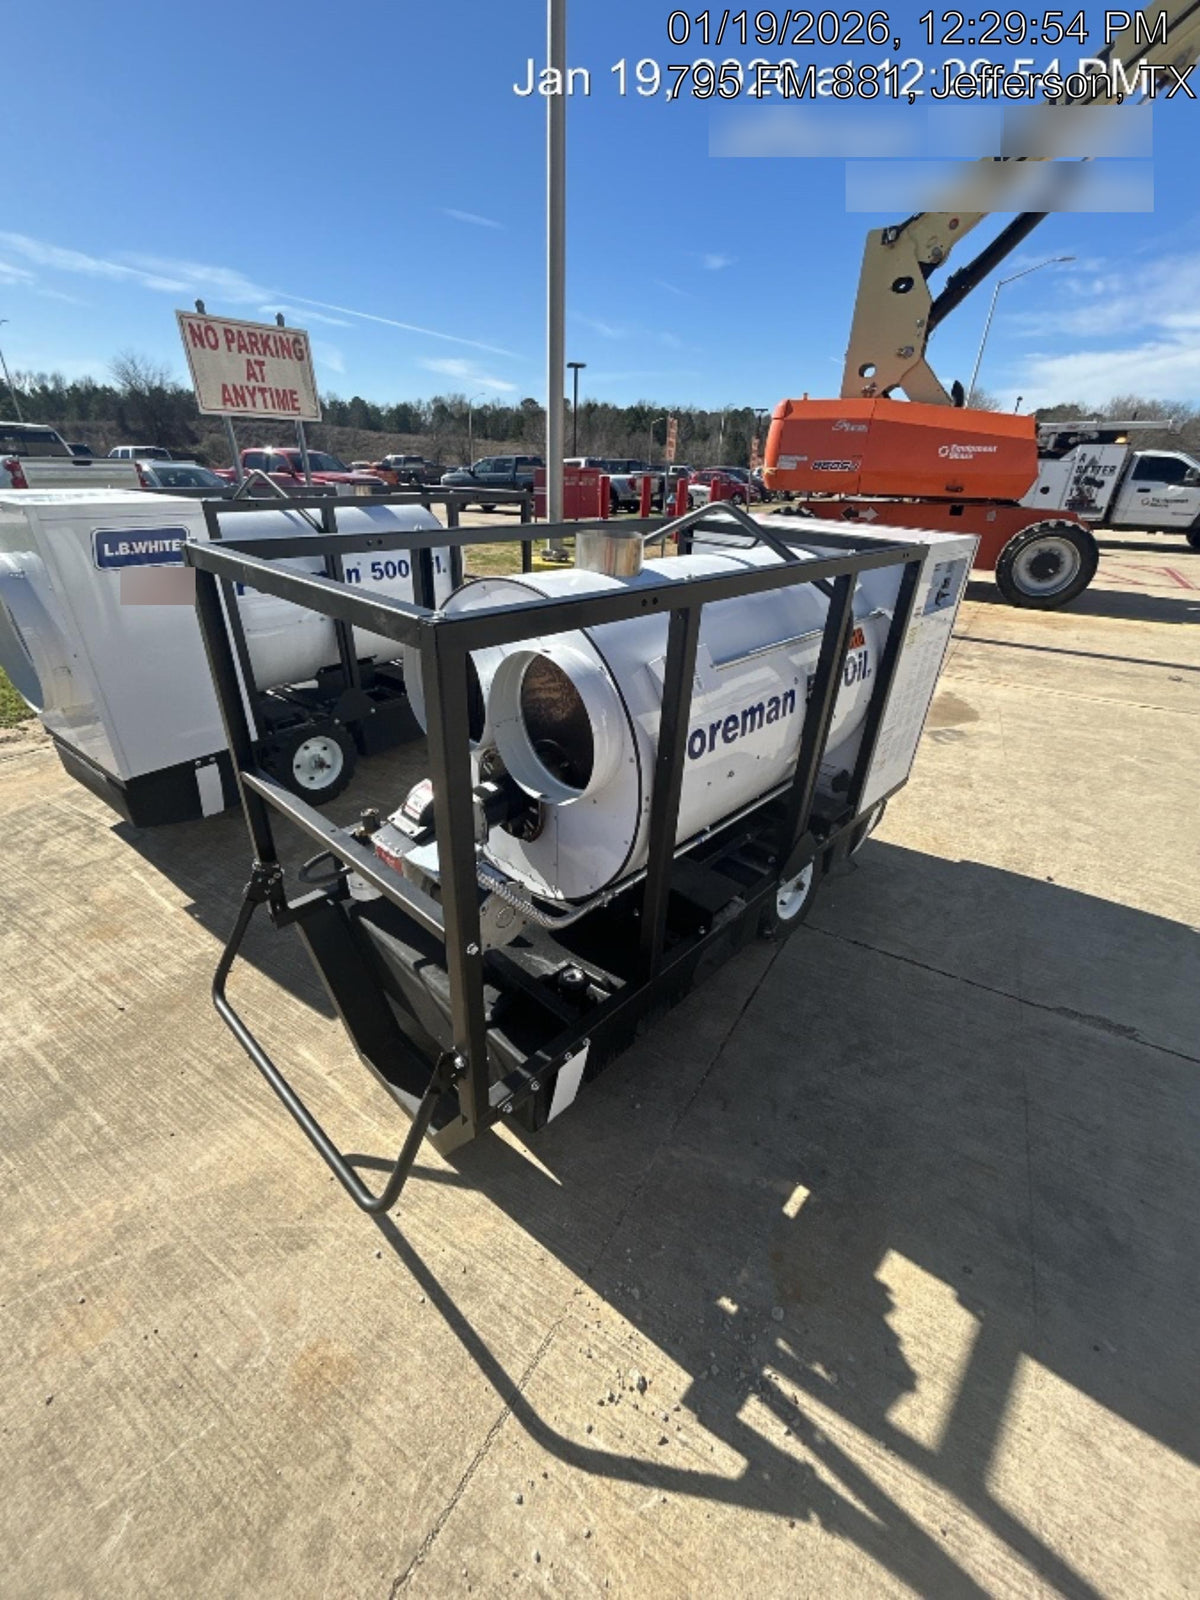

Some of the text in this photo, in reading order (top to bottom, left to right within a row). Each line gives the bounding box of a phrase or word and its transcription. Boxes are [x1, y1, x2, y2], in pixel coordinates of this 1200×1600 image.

[188, 322, 305, 361] NO PARKING
[246, 359, 266, 383] AT
[221, 383, 301, 411] ANYTIME
[103, 539, 182, 557] L.B.WHITE
[370, 559, 410, 581] 500
[686, 688, 797, 761] oreman
